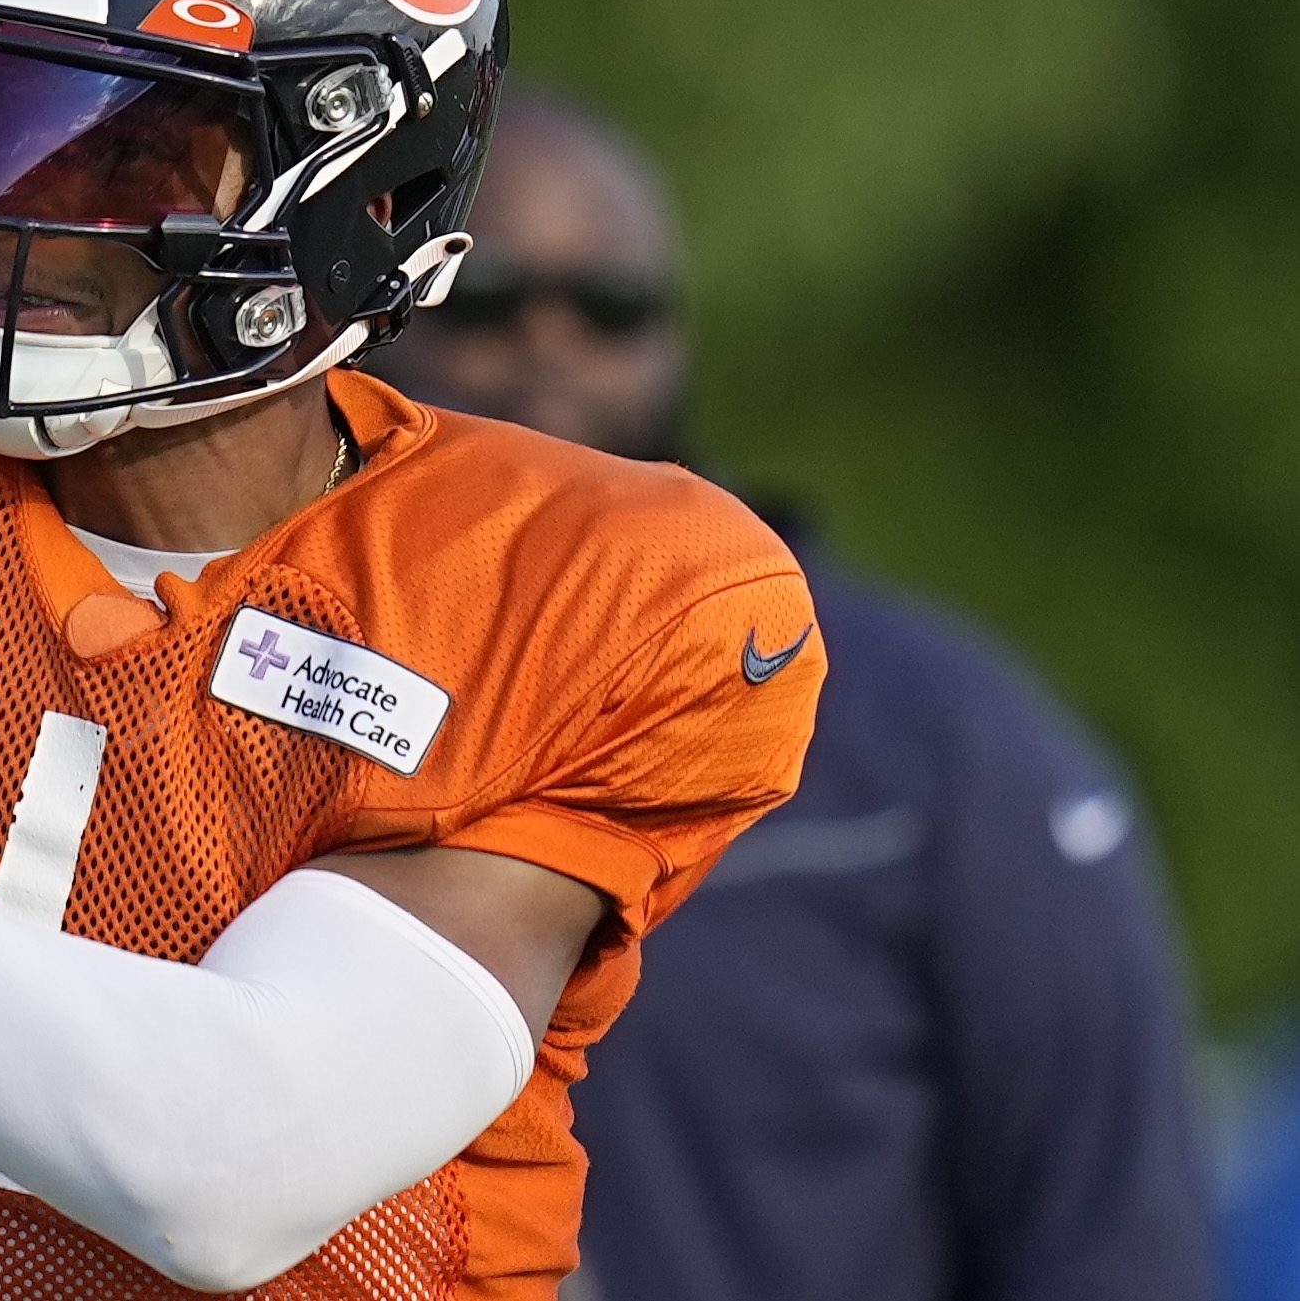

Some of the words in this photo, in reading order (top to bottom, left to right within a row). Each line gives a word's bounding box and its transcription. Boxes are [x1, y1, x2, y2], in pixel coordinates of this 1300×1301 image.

[293, 655, 397, 712] Advocate
[281, 685, 344, 726] Health
[350, 711, 411, 757] Care
